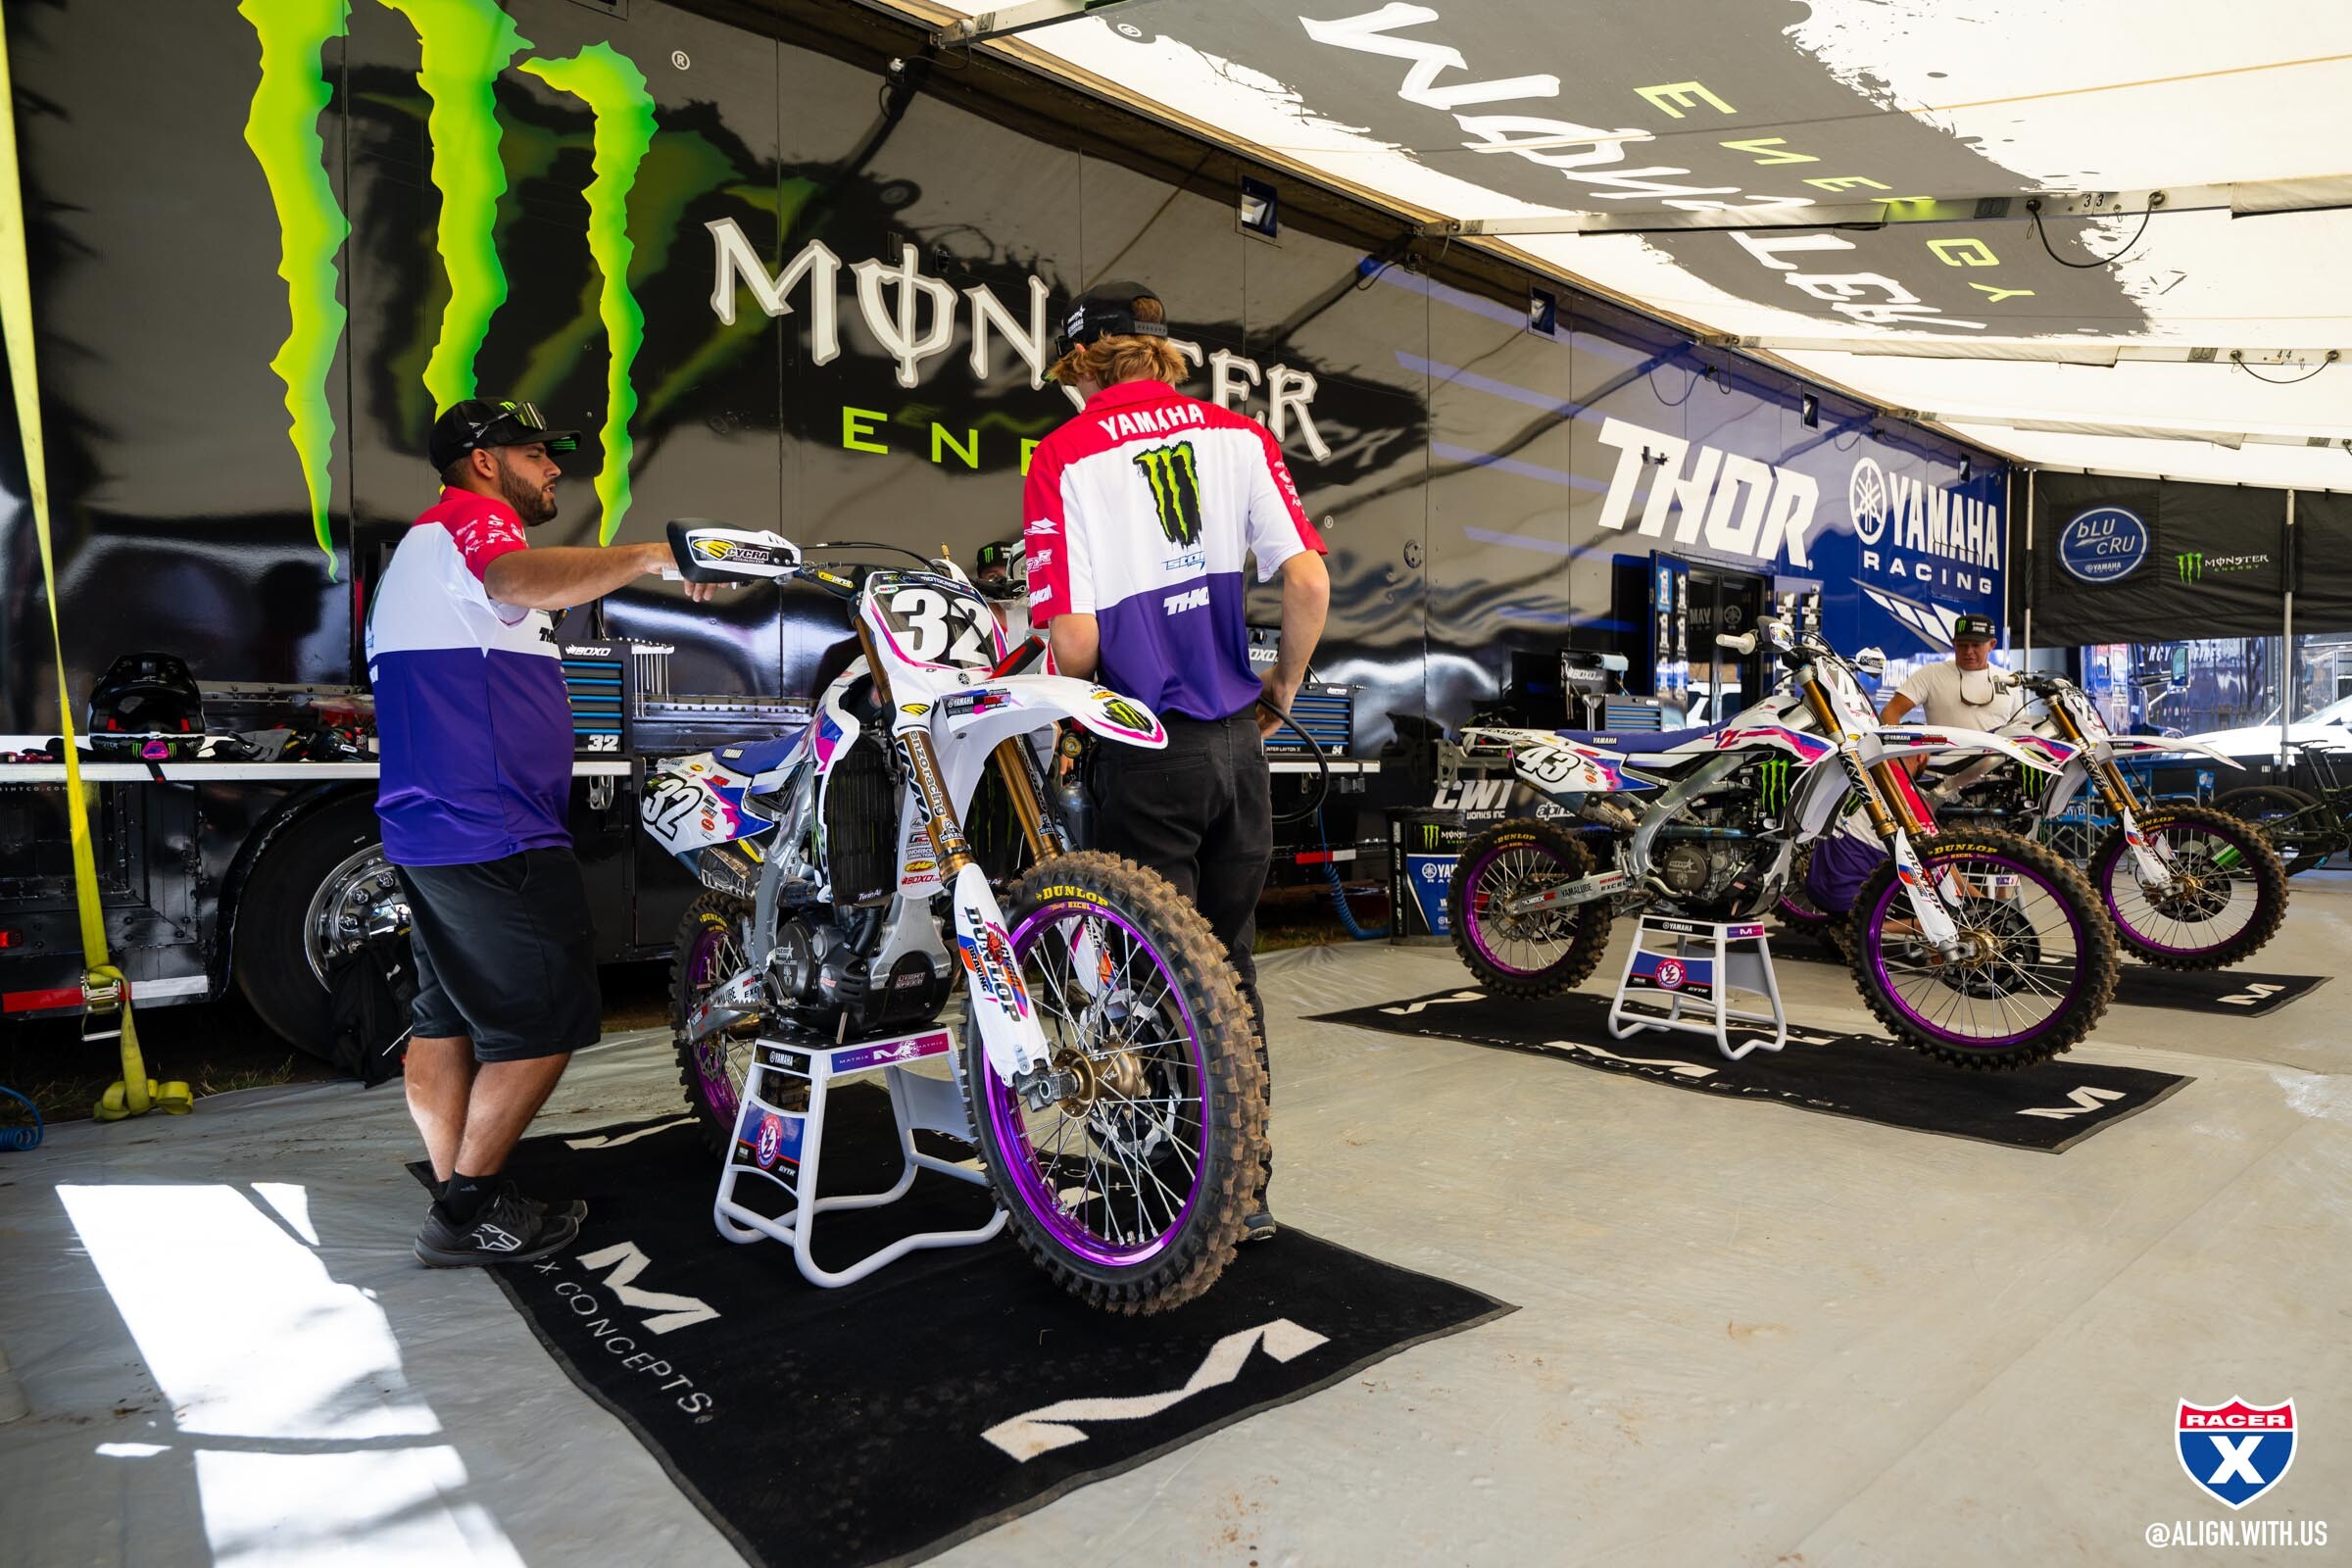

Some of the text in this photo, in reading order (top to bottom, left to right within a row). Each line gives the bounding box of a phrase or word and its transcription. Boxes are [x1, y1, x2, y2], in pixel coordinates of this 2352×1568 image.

[1597, 416, 1820, 568] THOR
[1888, 471, 2000, 571] YAMAHA
[726, 546, 770, 562] CYCRA
[2204, 554, 2270, 567] MONSTER
[1863, 550, 1992, 596] RACING
[890, 587, 994, 667] 32
[573, 646, 612, 657] BOXO
[587, 734, 620, 752] 32
[1592, 736, 1618, 746] YAMAHA
[1332, 744, 1344, 755] 54
[1514, 745, 1582, 784] 43
[642, 777, 704, 842] 32
[1934, 843, 1999, 855] DUNLOP
[1042, 885, 1110, 907] DUNLOP
[1560, 882, 1593, 898] YAMALUBE
[1669, 923, 1693, 933] YAMAHA
[774, 1052, 794, 1066] YAMAHA
